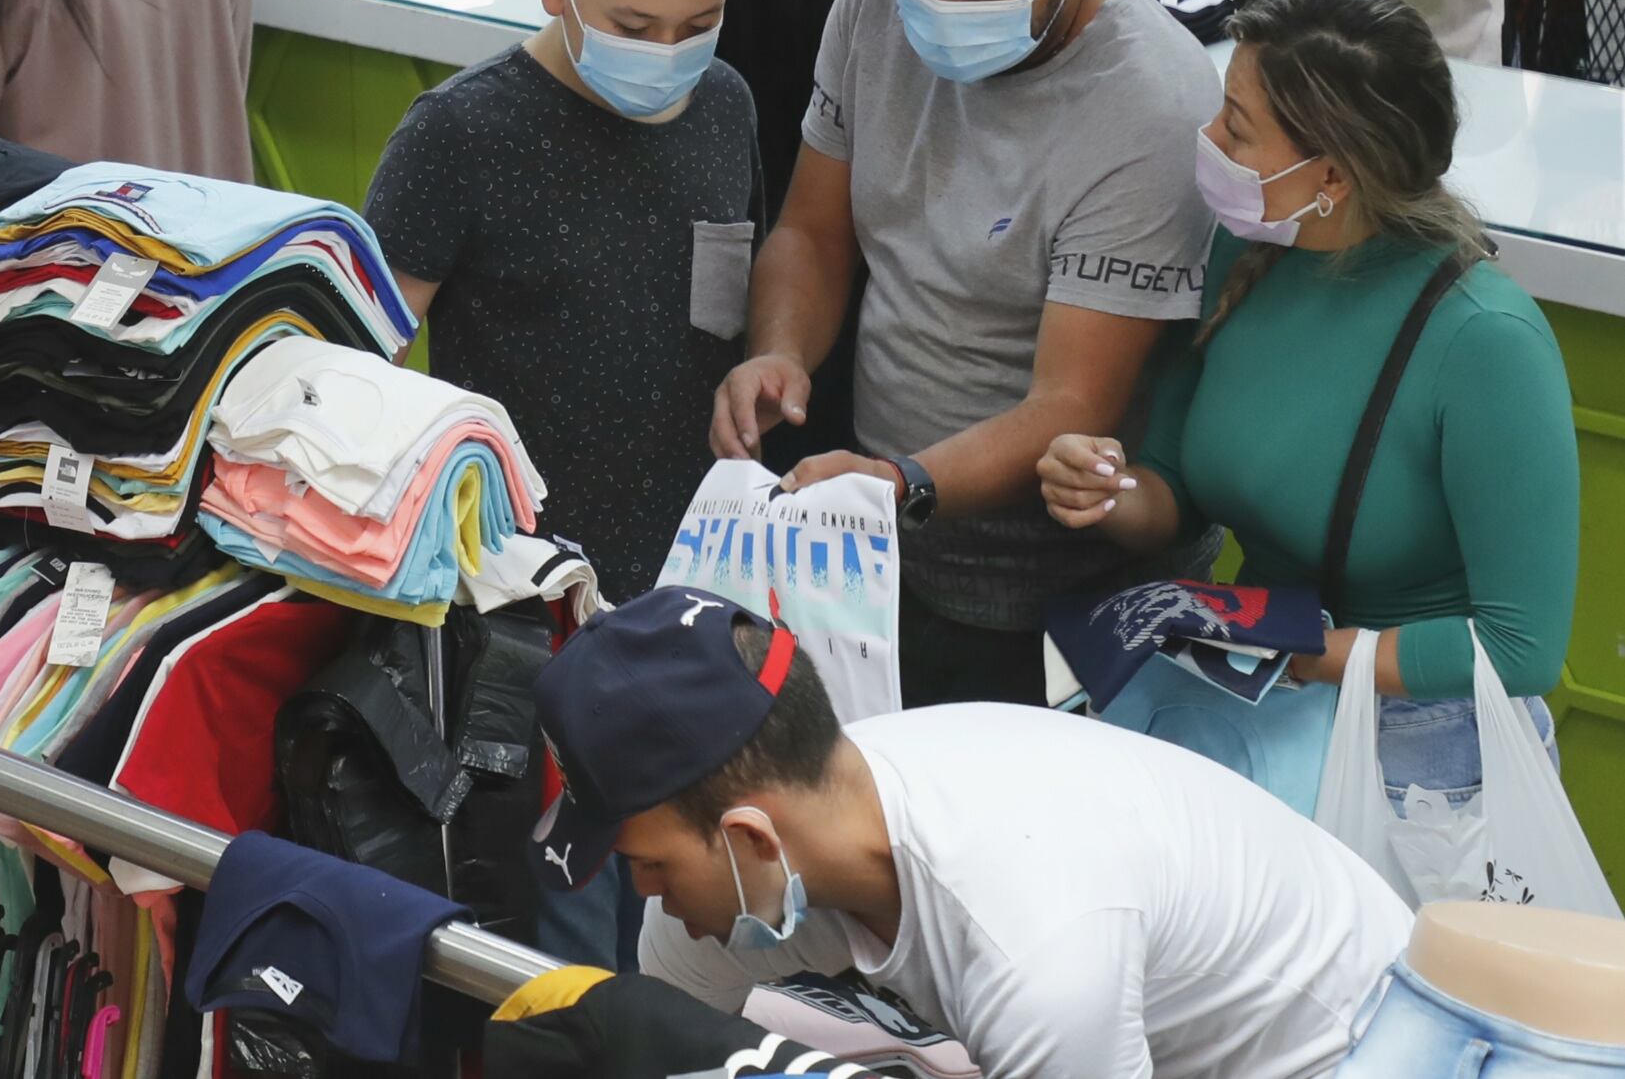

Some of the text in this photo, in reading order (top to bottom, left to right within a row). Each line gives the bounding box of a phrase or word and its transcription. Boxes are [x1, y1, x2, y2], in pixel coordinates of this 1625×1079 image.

[750, 501, 771, 519] THE
[778, 505, 809, 524] WITH
[821, 511, 866, 531] BRAND
